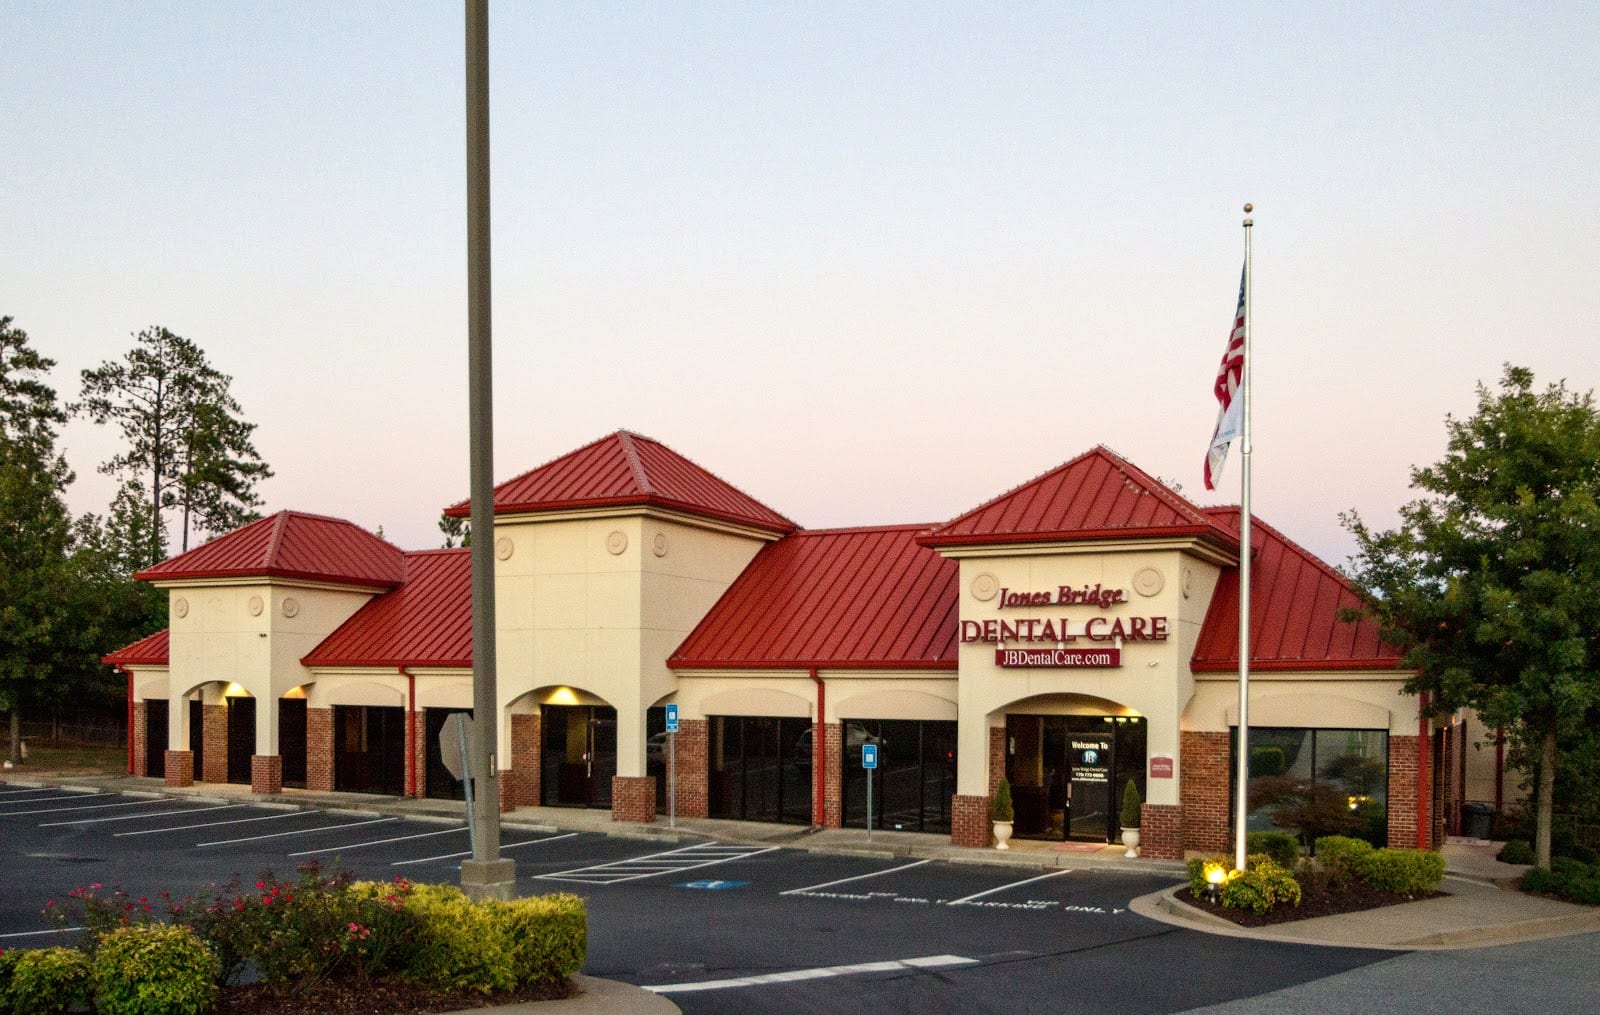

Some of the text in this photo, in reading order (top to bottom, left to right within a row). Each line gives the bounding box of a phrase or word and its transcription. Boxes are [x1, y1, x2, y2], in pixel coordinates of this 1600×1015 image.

[998, 583, 1124, 610] Jones Bridge
[960, 616, 1168, 643] DENTAL CARE
[1003, 650, 1110, 666] JBDentalCare.com
[1071, 741, 1109, 750] Welcome To
